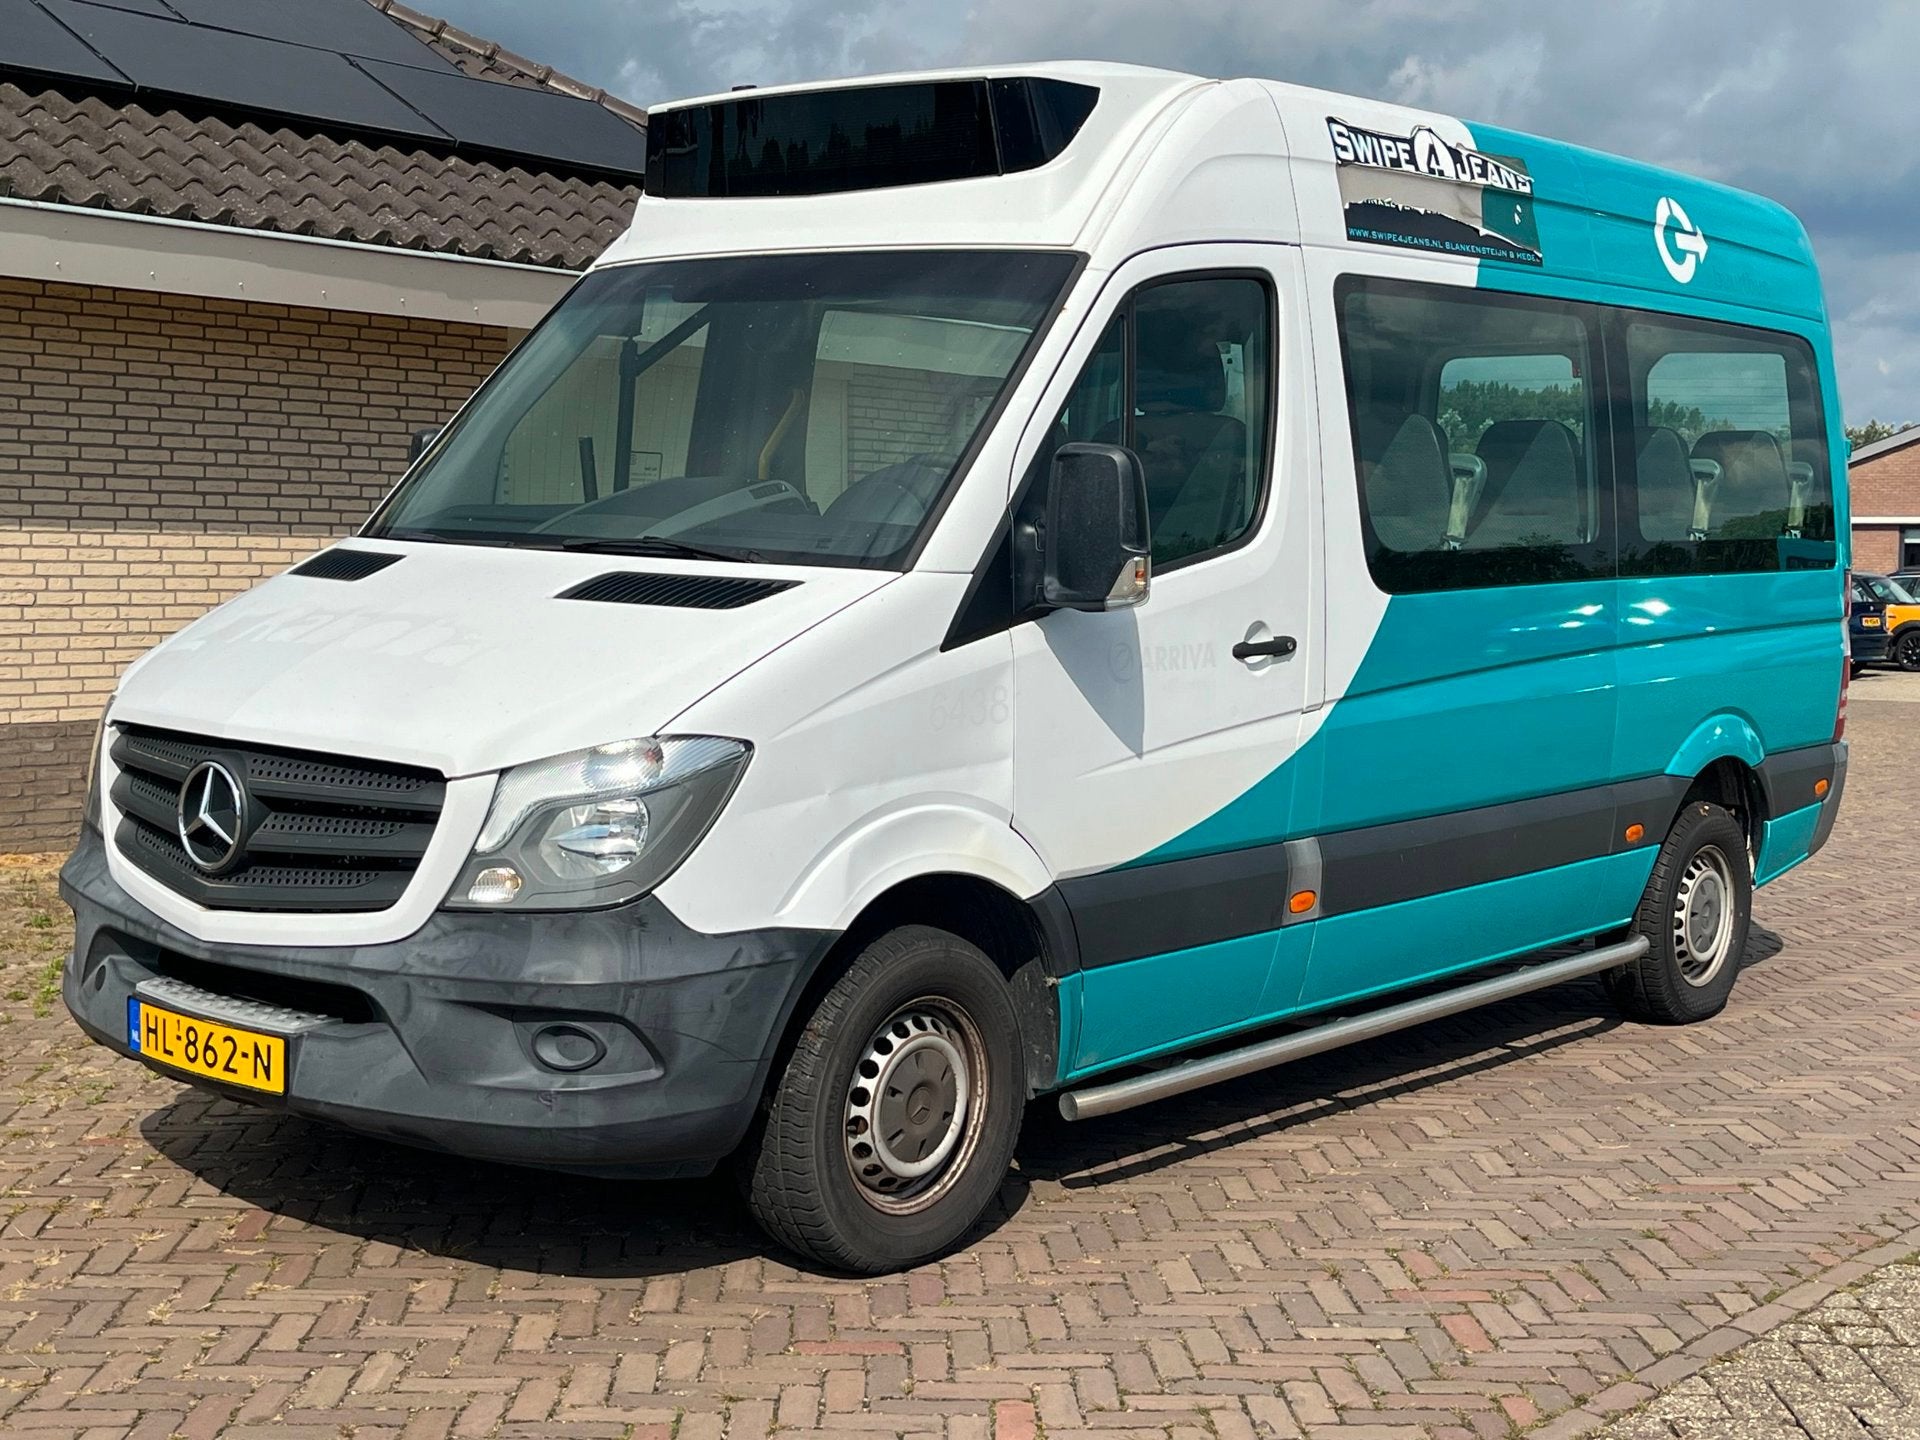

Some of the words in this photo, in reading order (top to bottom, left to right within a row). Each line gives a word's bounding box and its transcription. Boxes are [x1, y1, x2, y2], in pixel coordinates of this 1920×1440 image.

[1331, 123, 1417, 172] SWIPE
[1456, 151, 1532, 193] JEANS
[1348, 228, 1443, 248] WWW.SWIPE4JEANS.NL
[1445, 241, 1507, 258] BLANKENSTEIJN
[1142, 641, 1217, 672] ARRIVA
[146, 1012, 272, 1082] HL-862-N
